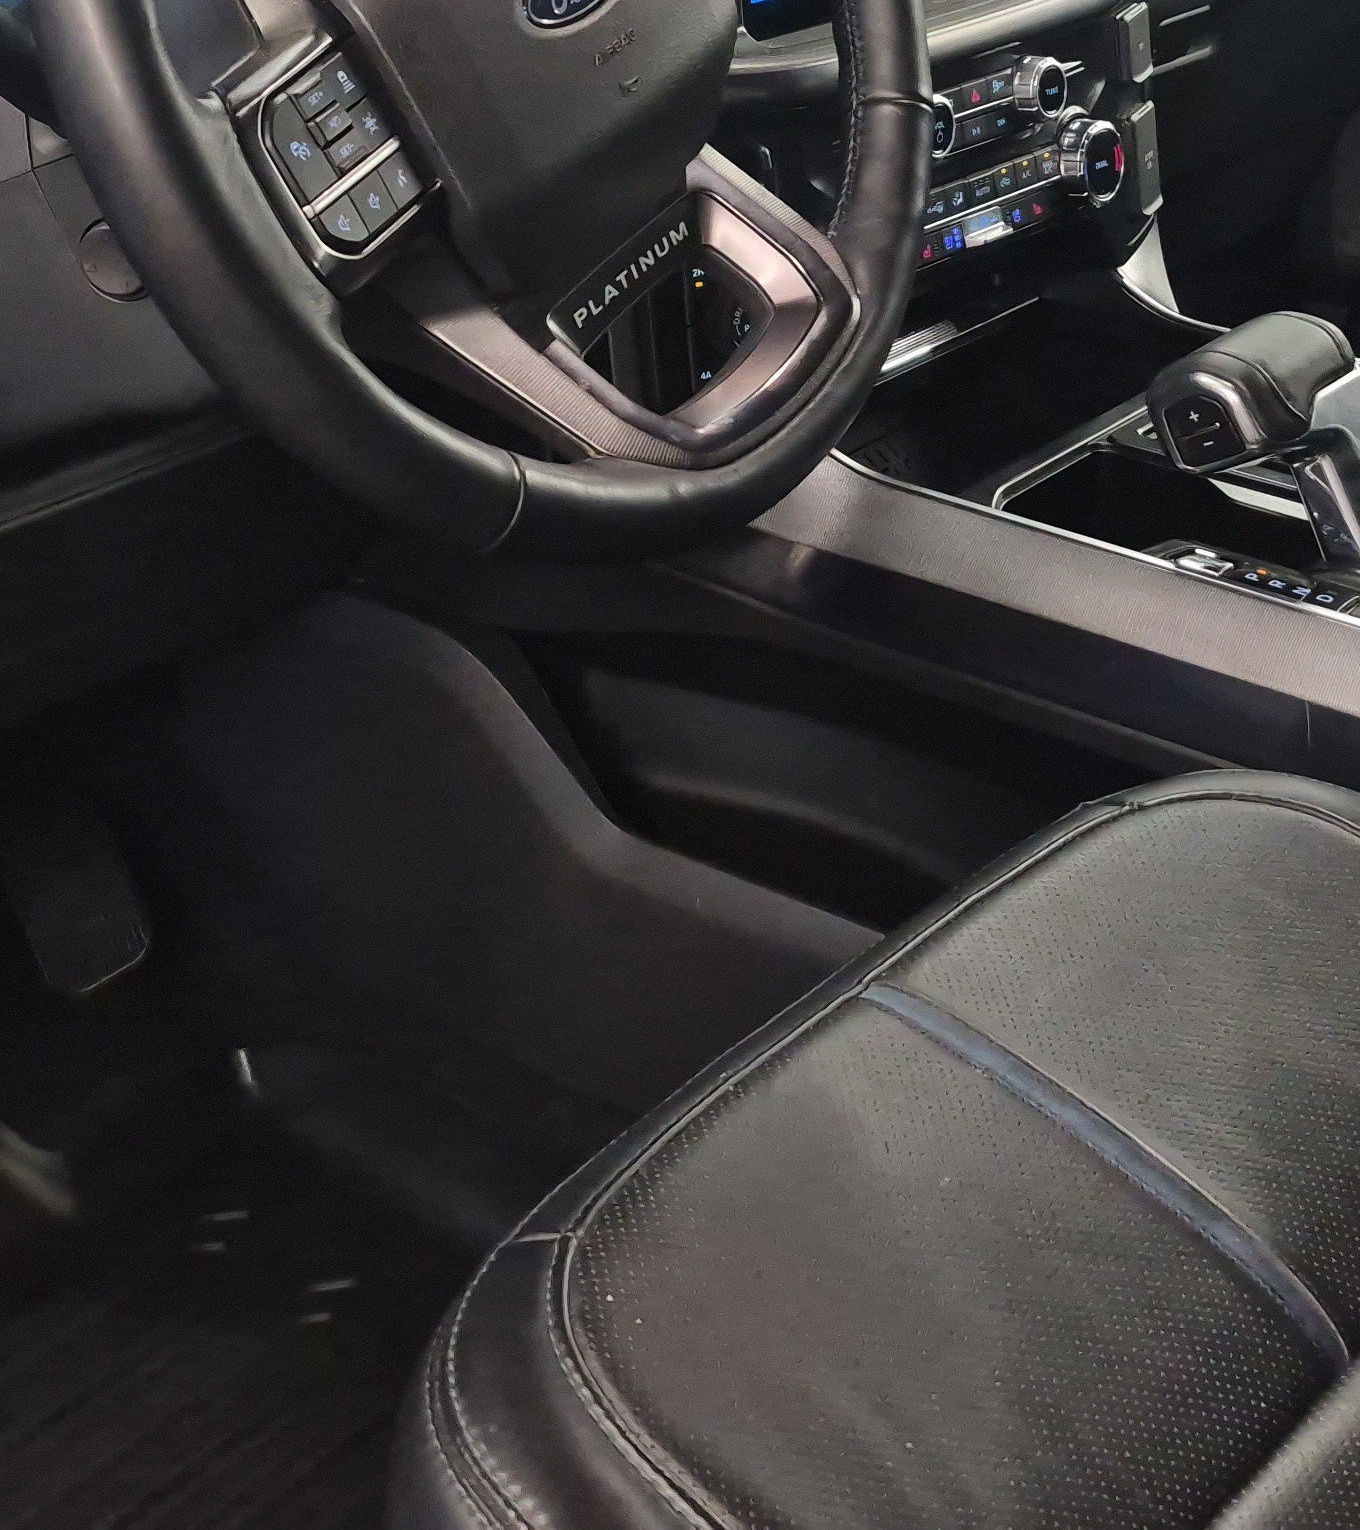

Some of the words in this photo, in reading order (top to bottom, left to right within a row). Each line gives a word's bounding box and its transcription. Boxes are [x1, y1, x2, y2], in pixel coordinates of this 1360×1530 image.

[572, 221, 690, 330] PLATINUM
[1244, 573, 1260, 583] P
[1268, 579, 1287, 590] R
[1291, 586, 1312, 597] N
[1315, 594, 1335, 604] D
